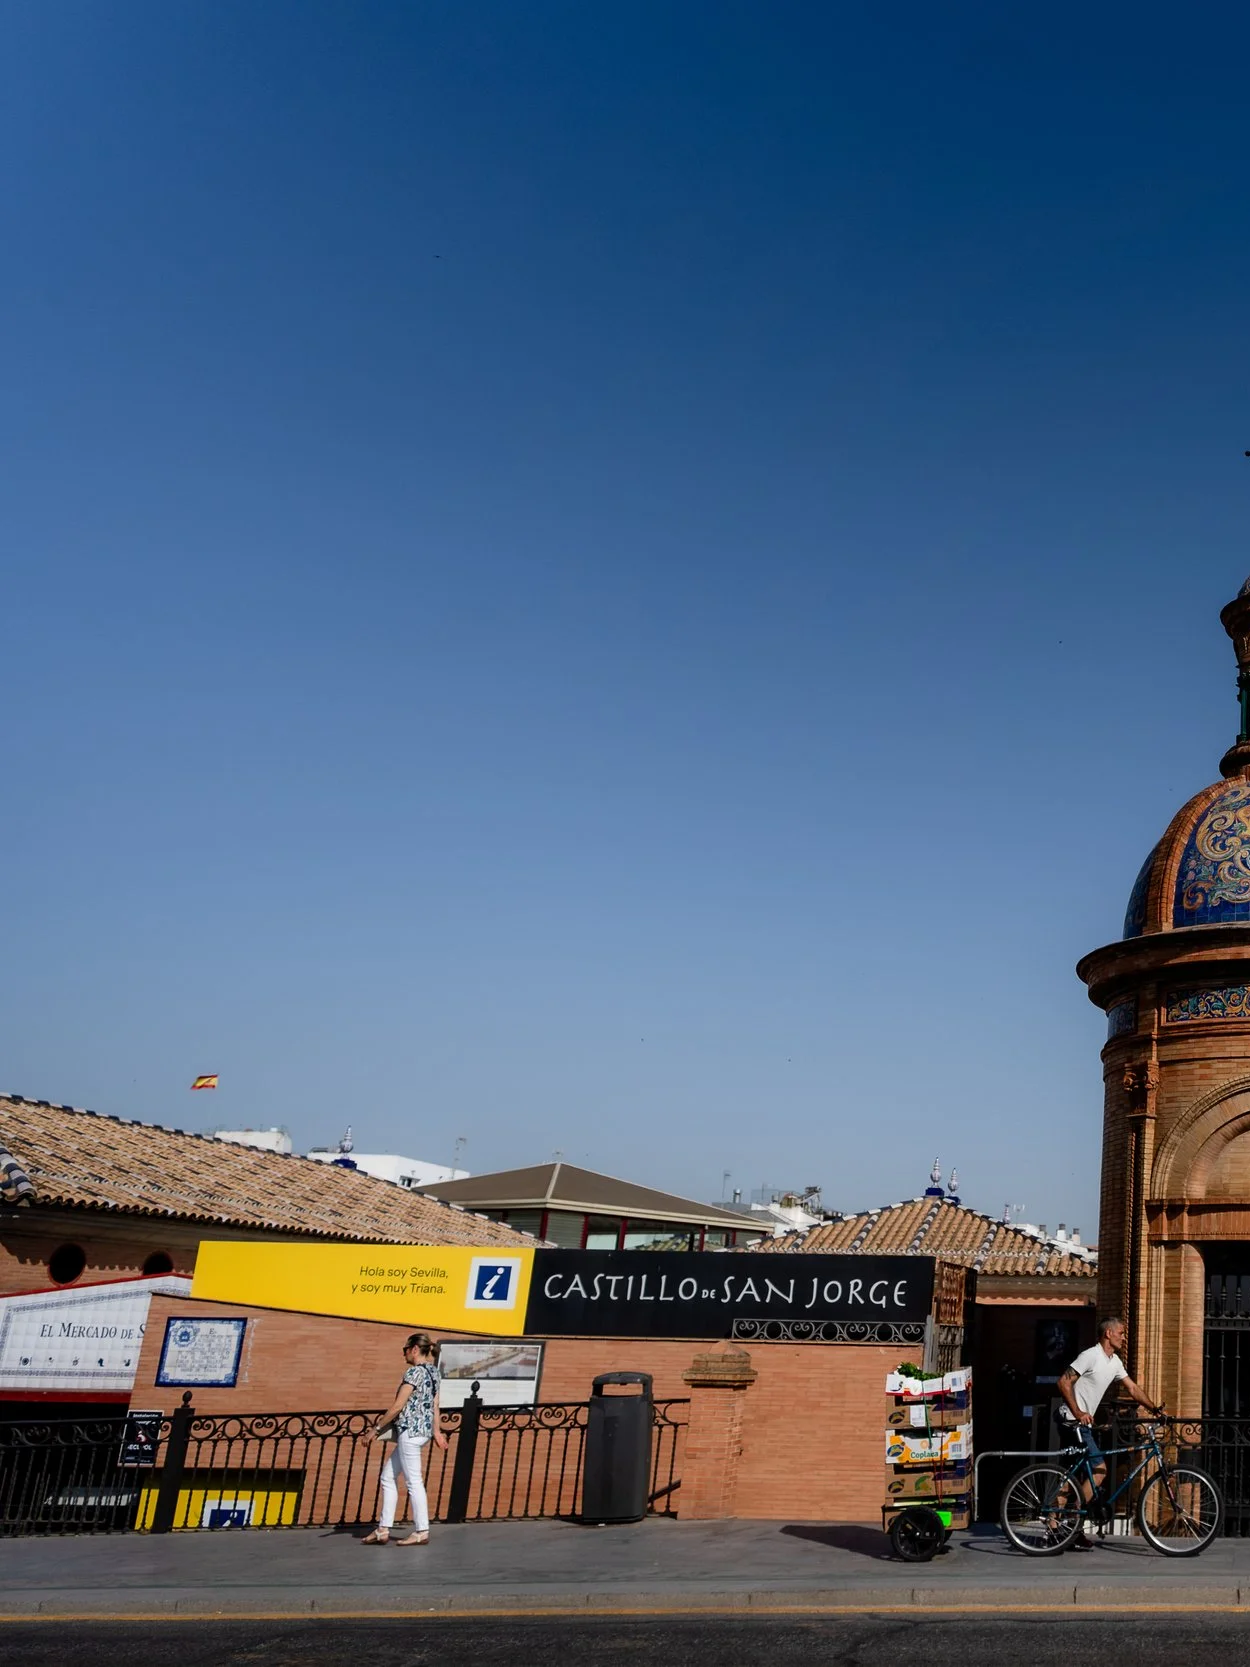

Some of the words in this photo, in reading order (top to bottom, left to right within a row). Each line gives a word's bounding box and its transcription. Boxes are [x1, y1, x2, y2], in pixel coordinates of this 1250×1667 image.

[360, 1266, 385, 1277] Hola
[387, 1268, 408, 1279] soy
[410, 1267, 448, 1279] Sevilla,
[352, 1284, 359, 1295] y
[360, 1284, 381, 1295] soy
[382, 1284, 407, 1295] muy
[410, 1282, 446, 1294] Triana.
[544, 1273, 699, 1301] CASTILLO
[701, 1288, 716, 1300] DE
[721, 1275, 795, 1304] SAN
[805, 1277, 907, 1309] JORGE
